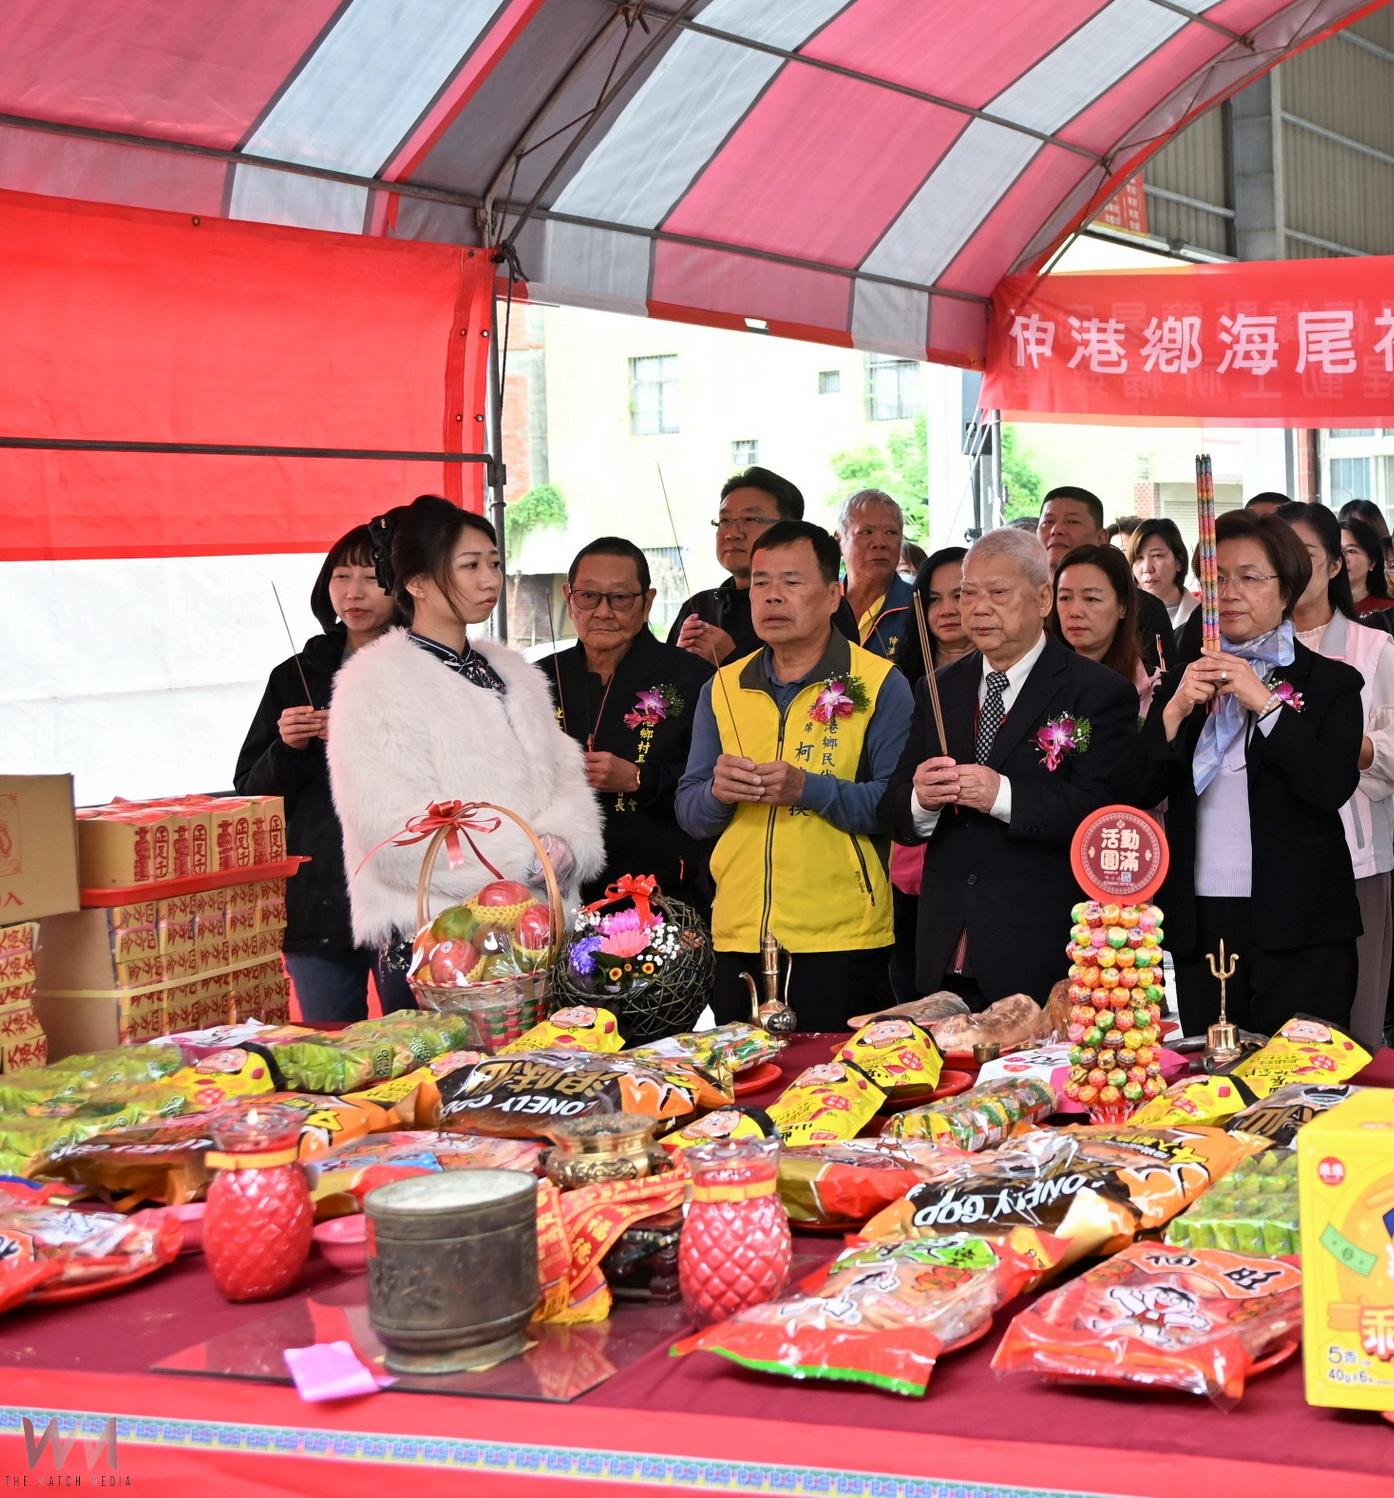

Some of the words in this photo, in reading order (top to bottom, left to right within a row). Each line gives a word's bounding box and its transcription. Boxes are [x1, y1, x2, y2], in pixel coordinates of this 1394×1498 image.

[1101, 828, 1140, 850] 活動
[1101, 850, 1140, 872] 圓滿
[994, 1173, 1104, 1216] ONELY
